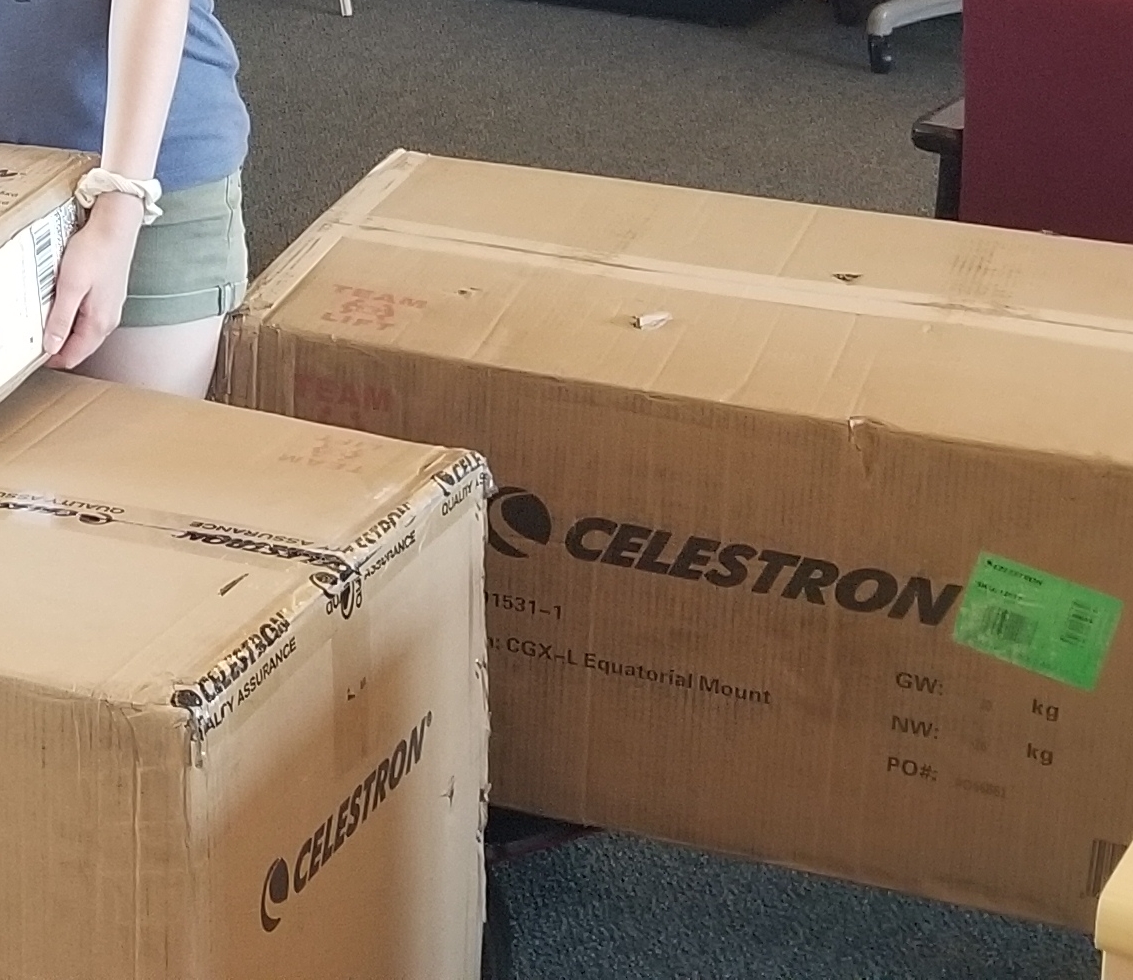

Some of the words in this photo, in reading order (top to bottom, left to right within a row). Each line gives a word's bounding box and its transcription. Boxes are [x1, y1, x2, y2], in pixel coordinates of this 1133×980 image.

[334, 284, 428, 308] TEAM
[441, 478, 473, 516] QUALITY
[189, 520, 315, 547] ASSURANCE
[565, 517, 962, 627] CELESTRON
[237, 636, 297, 707] ASSURANCE
[583, 652, 693, 691] Equatorial
[698, 675, 772, 706] Mount
[895, 671, 944, 696] GW:
[1031, 698, 1060, 722] kg
[891, 715, 939, 740] NW:
[1026, 742, 1054, 767] kg
[886, 756, 938, 782] PO#:
